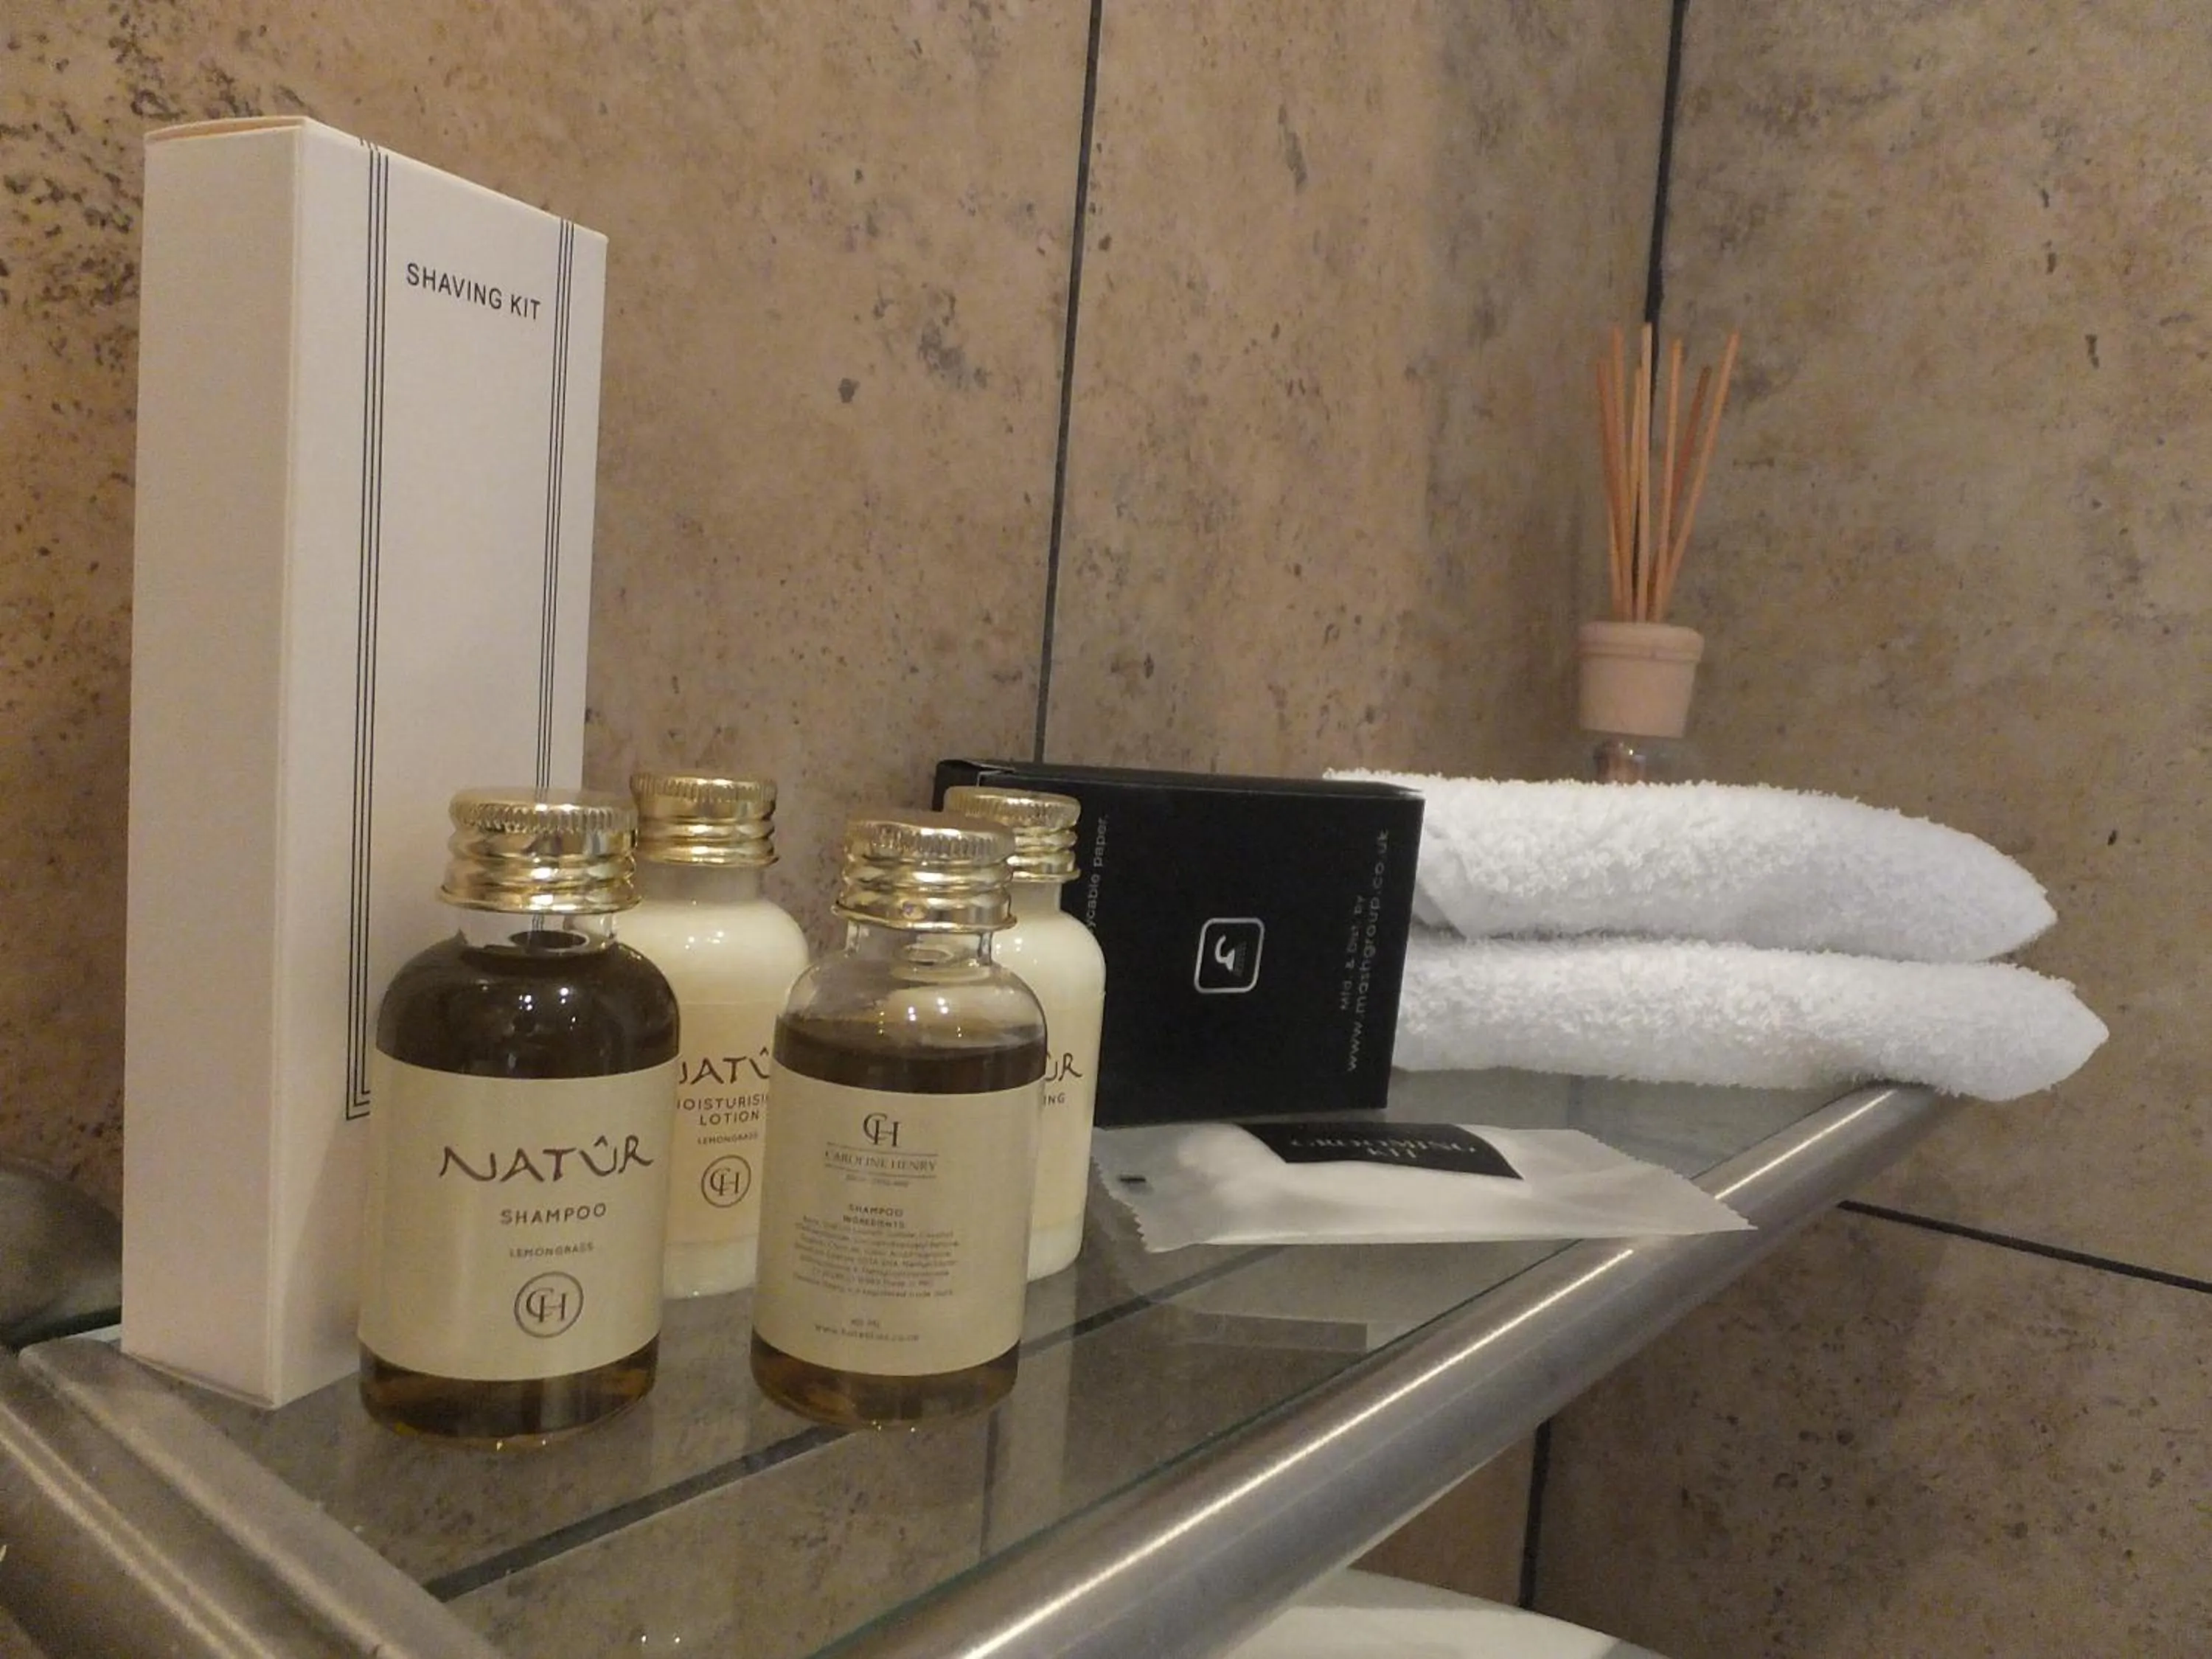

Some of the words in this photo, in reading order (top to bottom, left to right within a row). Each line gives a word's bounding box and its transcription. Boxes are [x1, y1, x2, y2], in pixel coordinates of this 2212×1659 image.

[406, 262, 502, 310] SHAVING
[510, 294, 540, 320] KIT
[1348, 829, 1389, 1071] www.mashgroup.co.uk
[700, 1110, 759, 1126] LOTION
[500, 1203, 607, 1225] SHAMPOO
[848, 1203, 904, 1218] SHAMPOO
[509, 1242, 594, 1258] LEMONGRASS
